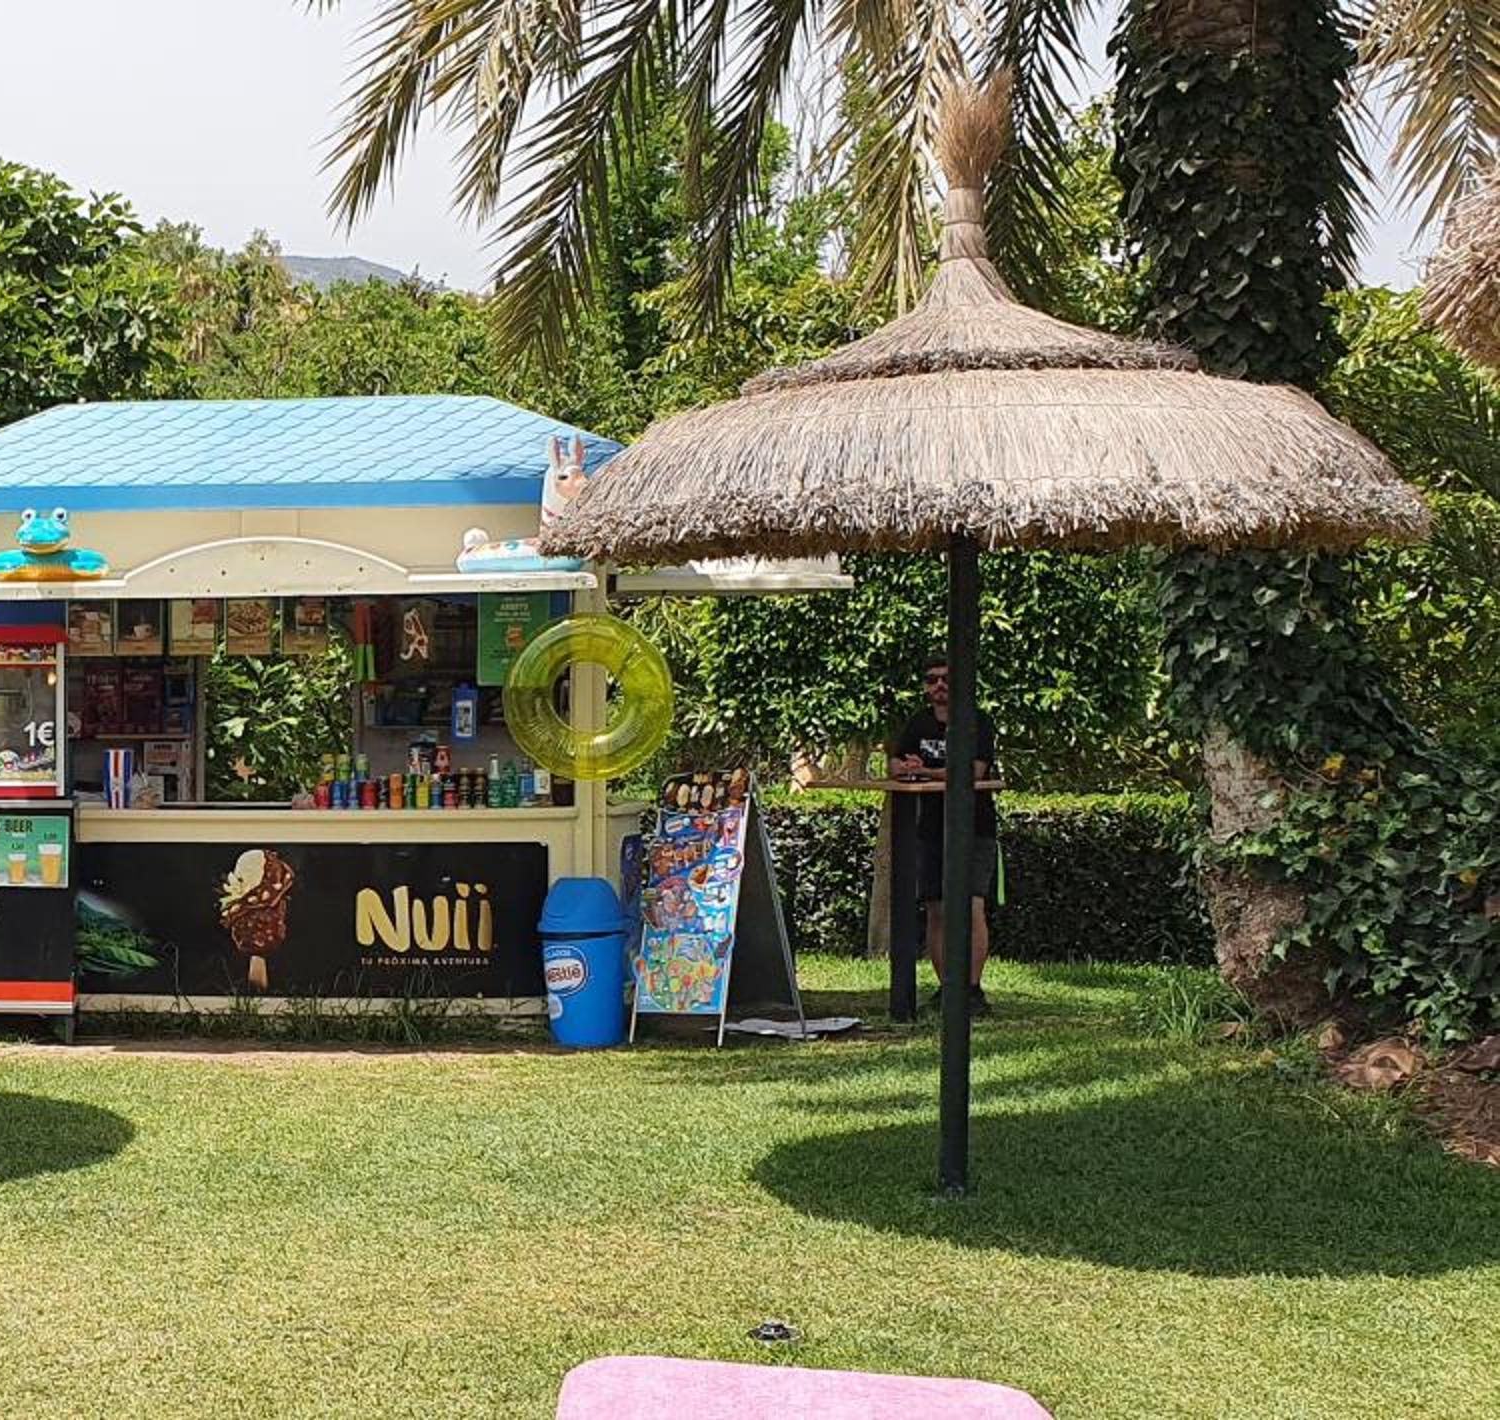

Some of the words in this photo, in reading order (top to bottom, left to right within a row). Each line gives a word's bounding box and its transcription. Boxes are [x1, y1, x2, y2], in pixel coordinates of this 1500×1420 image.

[23, 721, 55, 747] 1€
[4, 819, 33, 832] BEER
[355, 882, 494, 952] Nuii
[361, 957, 373, 966] TU
[377, 955, 429, 966] PRÓXIMA
[433, 957, 490, 966] AVENTURA
